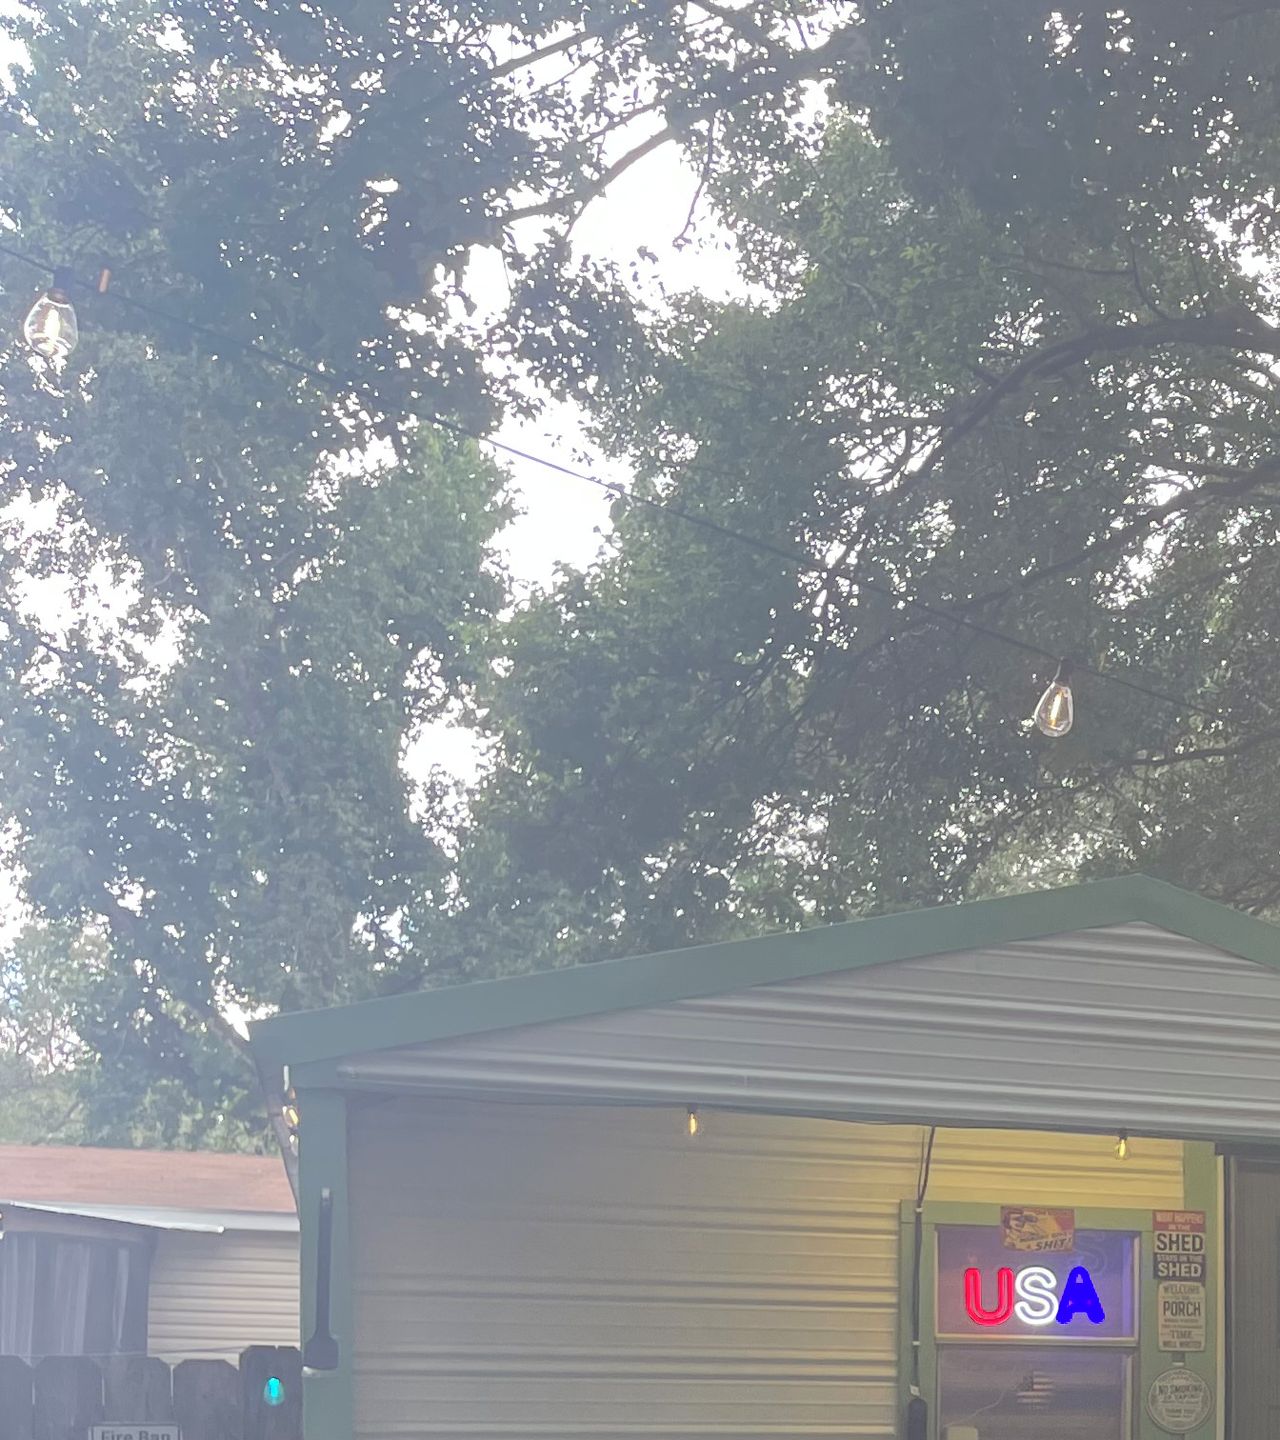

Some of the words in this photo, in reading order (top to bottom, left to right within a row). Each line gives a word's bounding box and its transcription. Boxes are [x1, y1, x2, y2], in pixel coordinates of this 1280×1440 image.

[1036, 1238, 1072, 1250] SHIT!
[1157, 1233, 1203, 1252] SHED
[1158, 1263, 1202, 1278] SHED
[964, 1265, 1105, 1327] USA
[1163, 1301, 1201, 1317] PORCH
